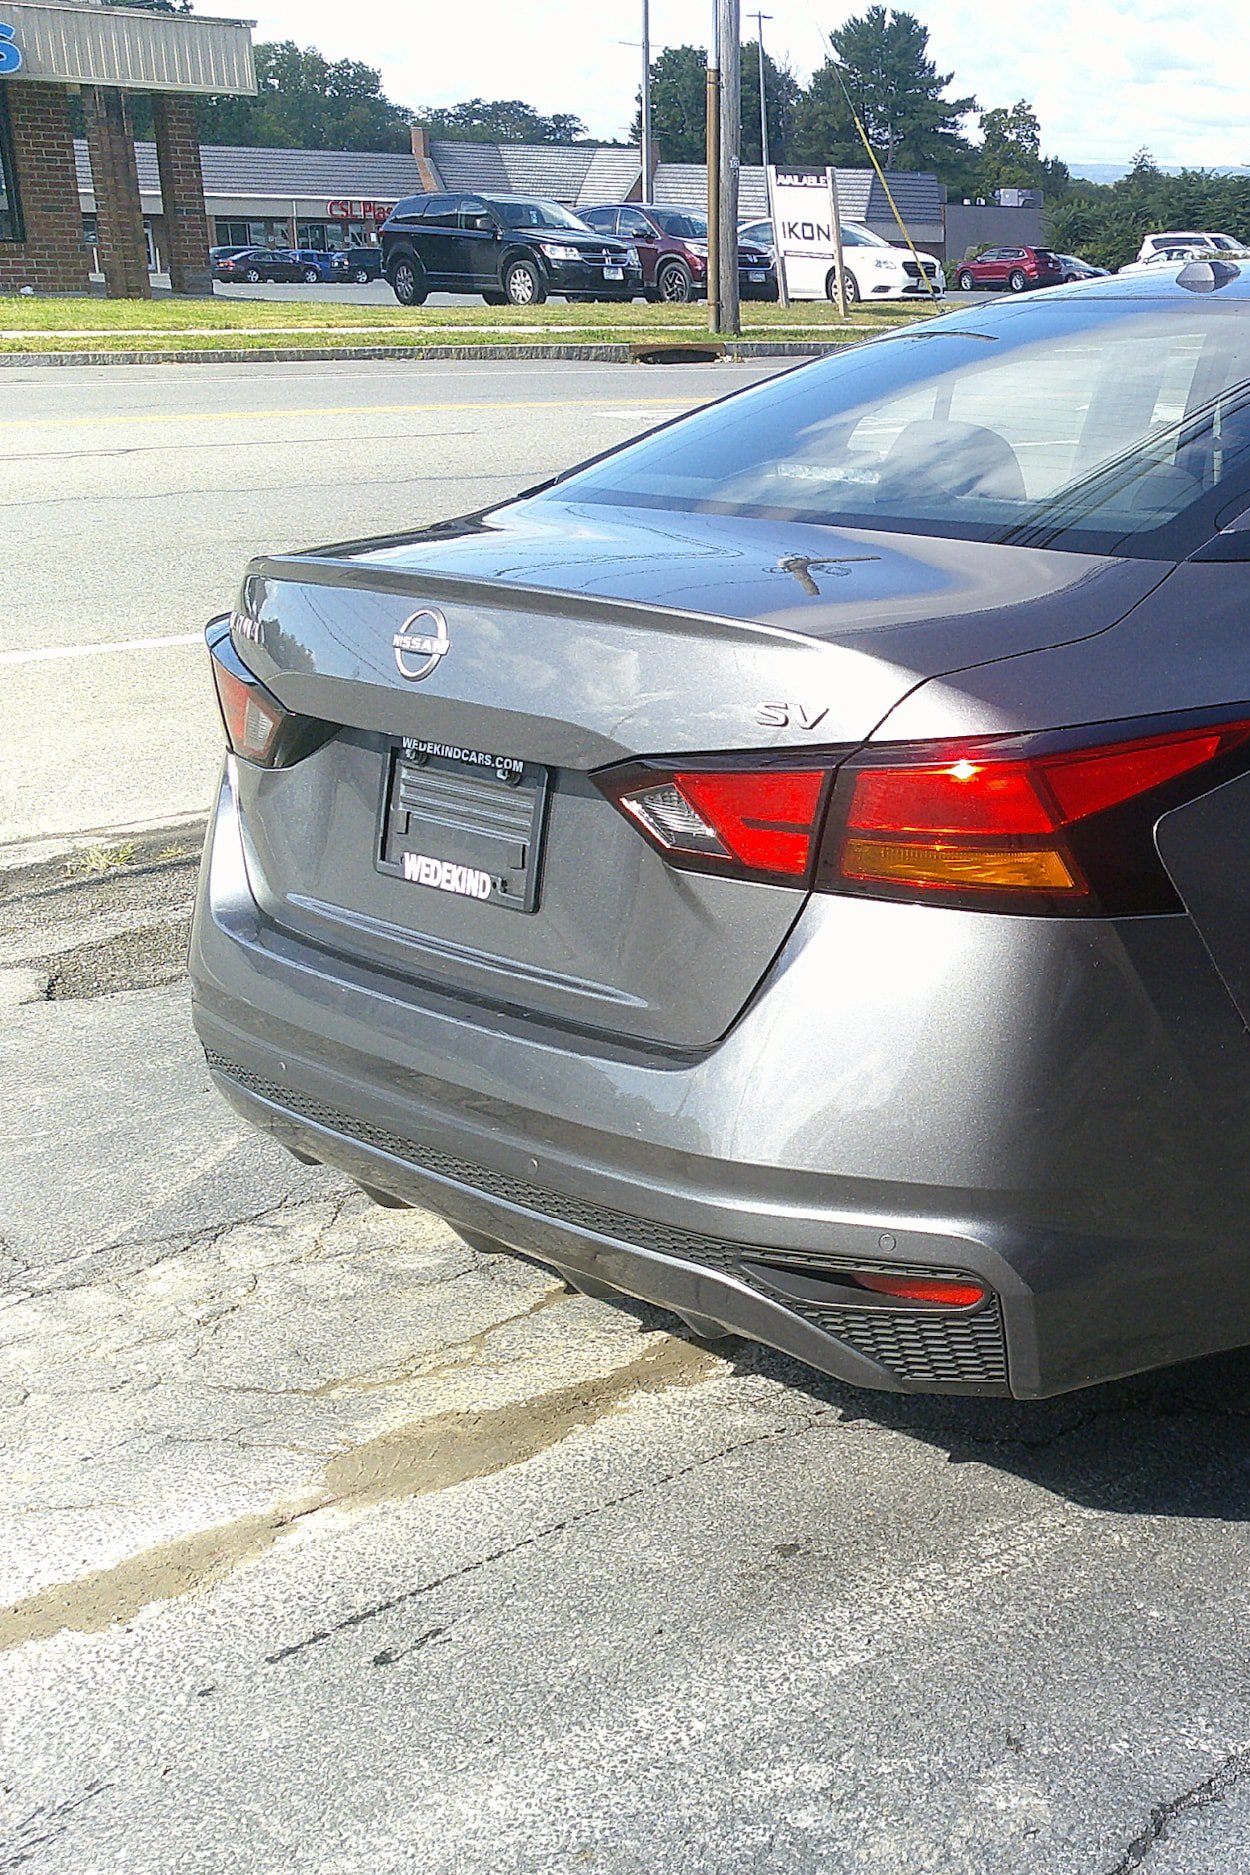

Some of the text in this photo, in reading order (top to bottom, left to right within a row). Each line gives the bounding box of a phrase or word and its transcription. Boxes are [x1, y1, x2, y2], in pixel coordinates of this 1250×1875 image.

[327, 200, 393, 220] CSL Plas
[781, 221, 831, 241] IKON
[392, 633, 449, 655] NISSAN
[755, 700, 829, 730] SV
[402, 736, 524, 773] WEDEKINDCARS.COM
[404, 852, 492, 899] WEDEKIND
